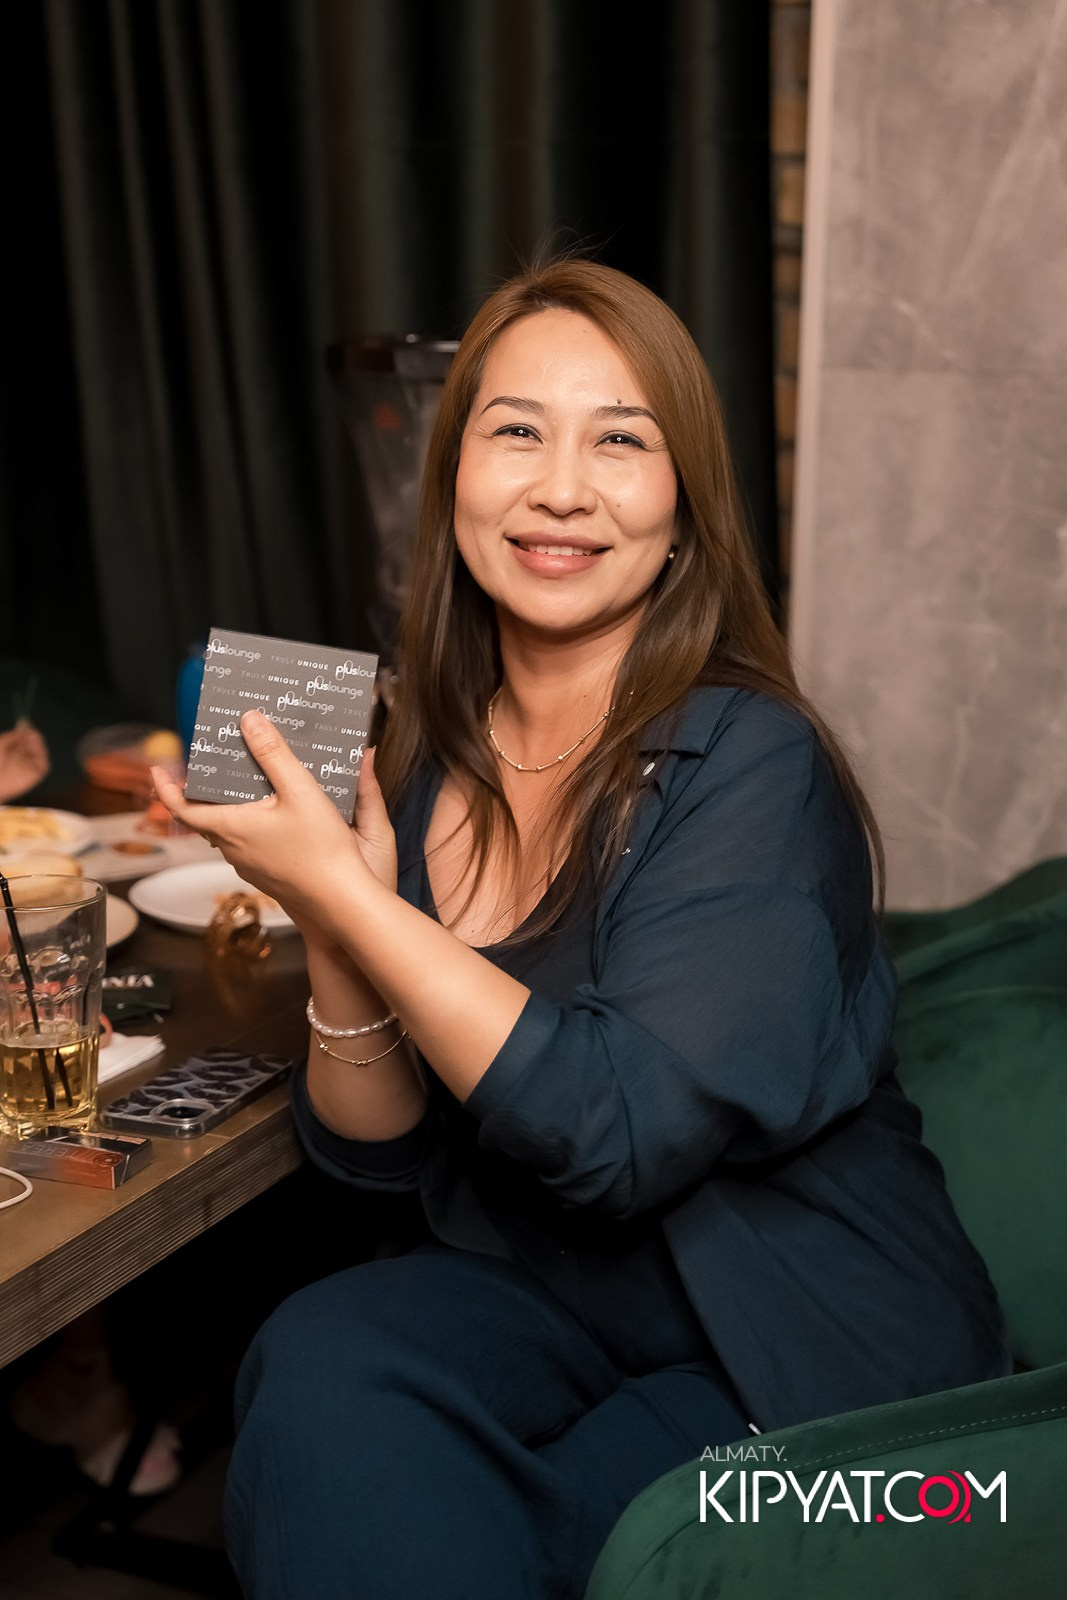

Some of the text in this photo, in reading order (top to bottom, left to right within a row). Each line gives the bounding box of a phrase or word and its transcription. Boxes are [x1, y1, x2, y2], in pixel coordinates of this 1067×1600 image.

[271, 655, 295, 665] TRULY
[297, 660, 329, 671] UNIQUE
[241, 670, 266, 680] TRULY
[268, 675, 300, 686] UNIQUE
[306, 675, 364, 699] pluslounge
[212, 686, 236, 695] TRULY
[239, 690, 271, 701] UNIQUE
[277, 690, 335, 715] pluslounge
[343, 707, 367, 717] TRULY
[209, 706, 241, 717] UNIQUE
[314, 723, 338, 732] TRULY
[311, 743, 343, 754] UNIQUE
[226, 769, 251, 779] TRULY
[197, 785, 221, 794] TRULY
[223, 789, 256, 800] UNIQUE
